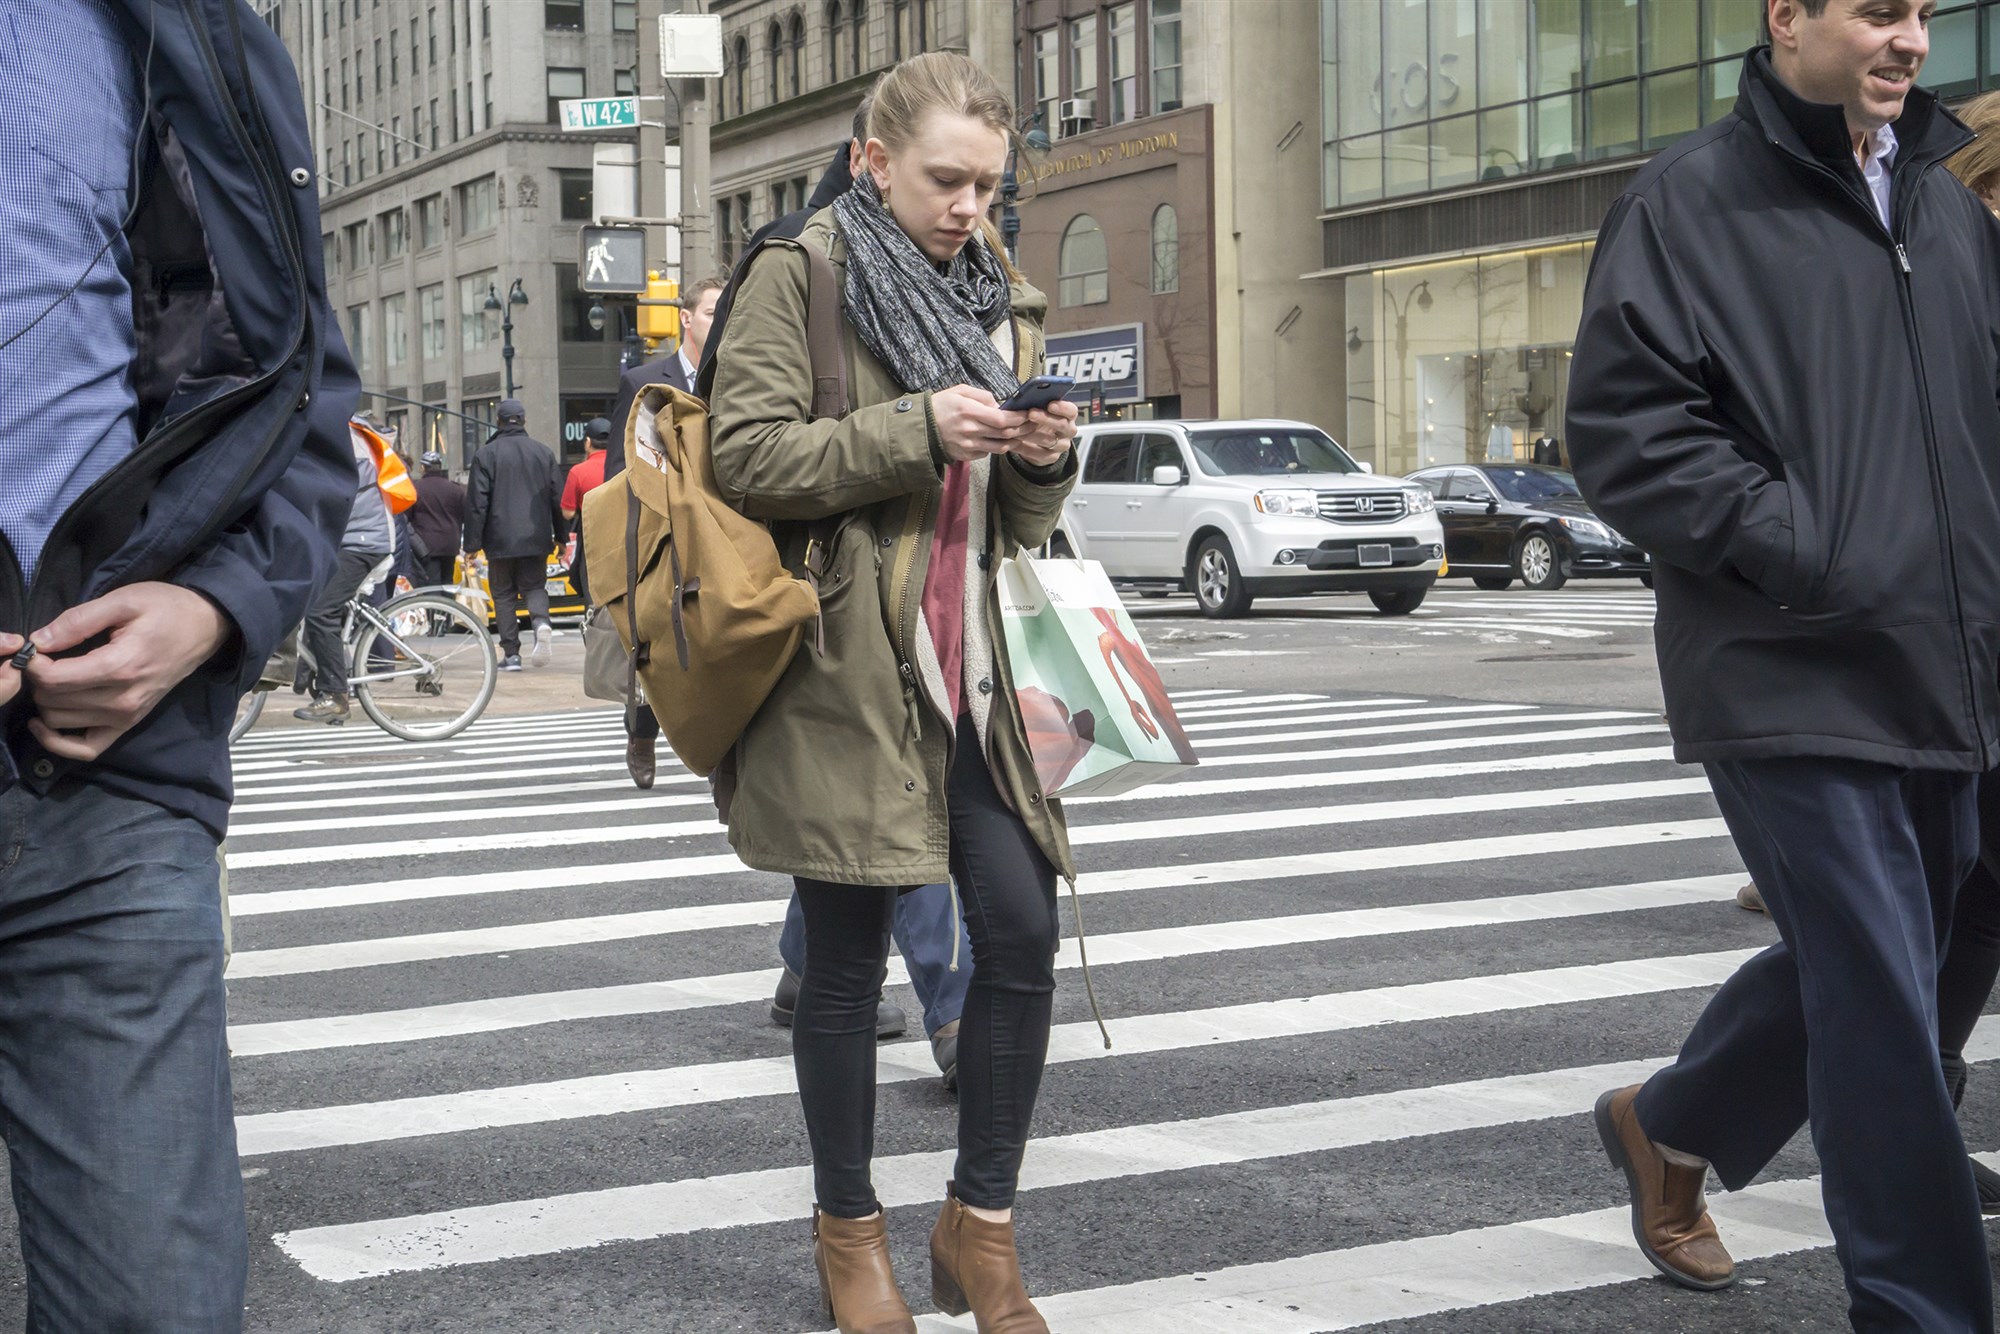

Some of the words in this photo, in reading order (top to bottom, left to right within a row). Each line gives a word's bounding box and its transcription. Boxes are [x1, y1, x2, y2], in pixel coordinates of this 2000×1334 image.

[1369, 53, 1460, 119] COS
[583, 103, 597, 125] W
[600, 101, 622, 124] 42
[623, 101, 634, 113] ST
[1097, 147, 1113, 165] OF
[1119, 131, 1178, 160] MIDTOWN
[565, 422, 588, 441] OU
